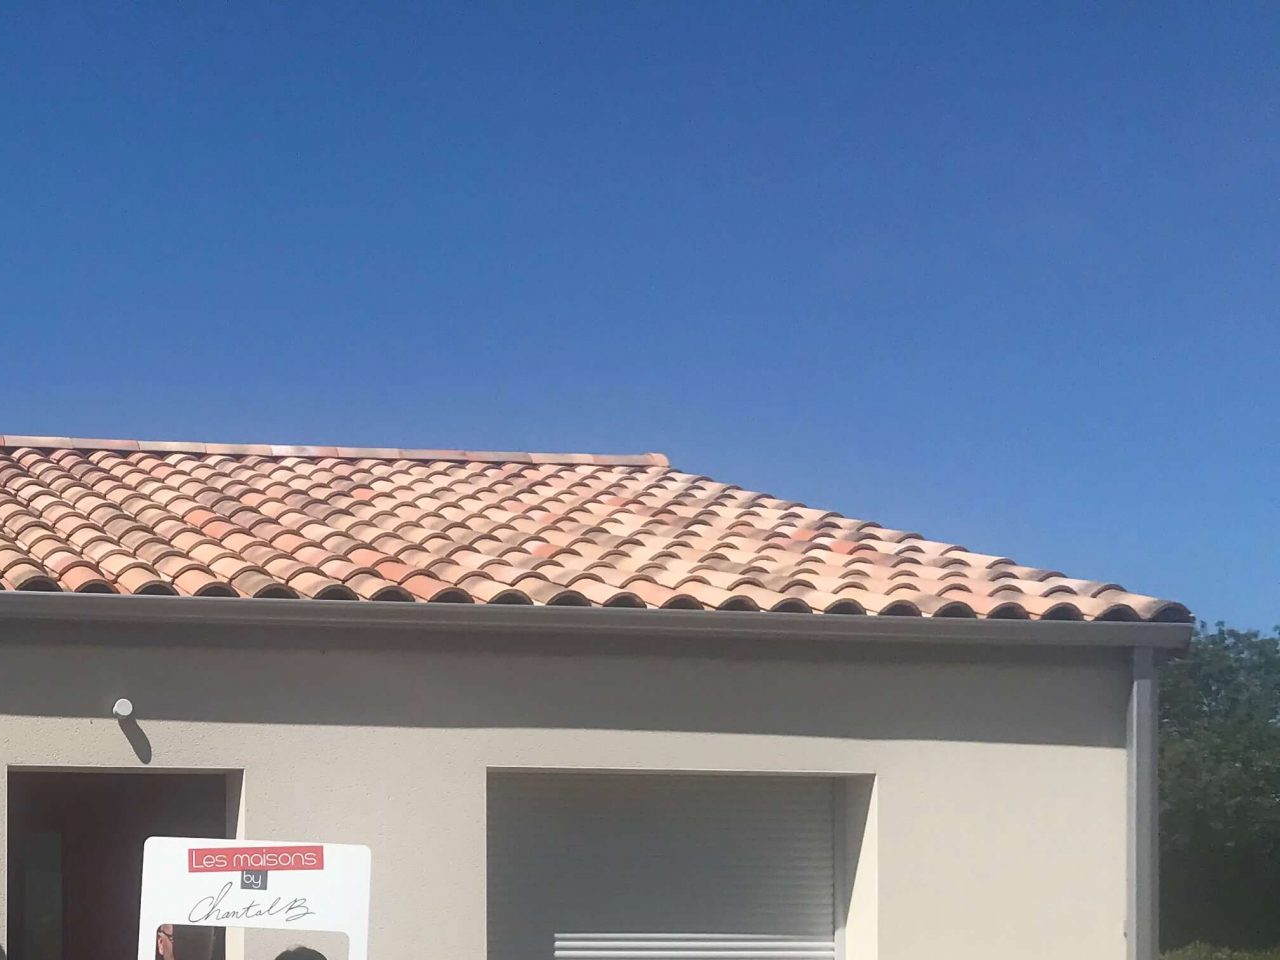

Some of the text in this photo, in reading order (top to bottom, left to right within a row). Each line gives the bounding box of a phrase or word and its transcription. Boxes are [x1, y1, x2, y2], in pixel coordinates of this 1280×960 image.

[193, 849, 316, 868] Les maisons
[243, 871, 261, 888] by
